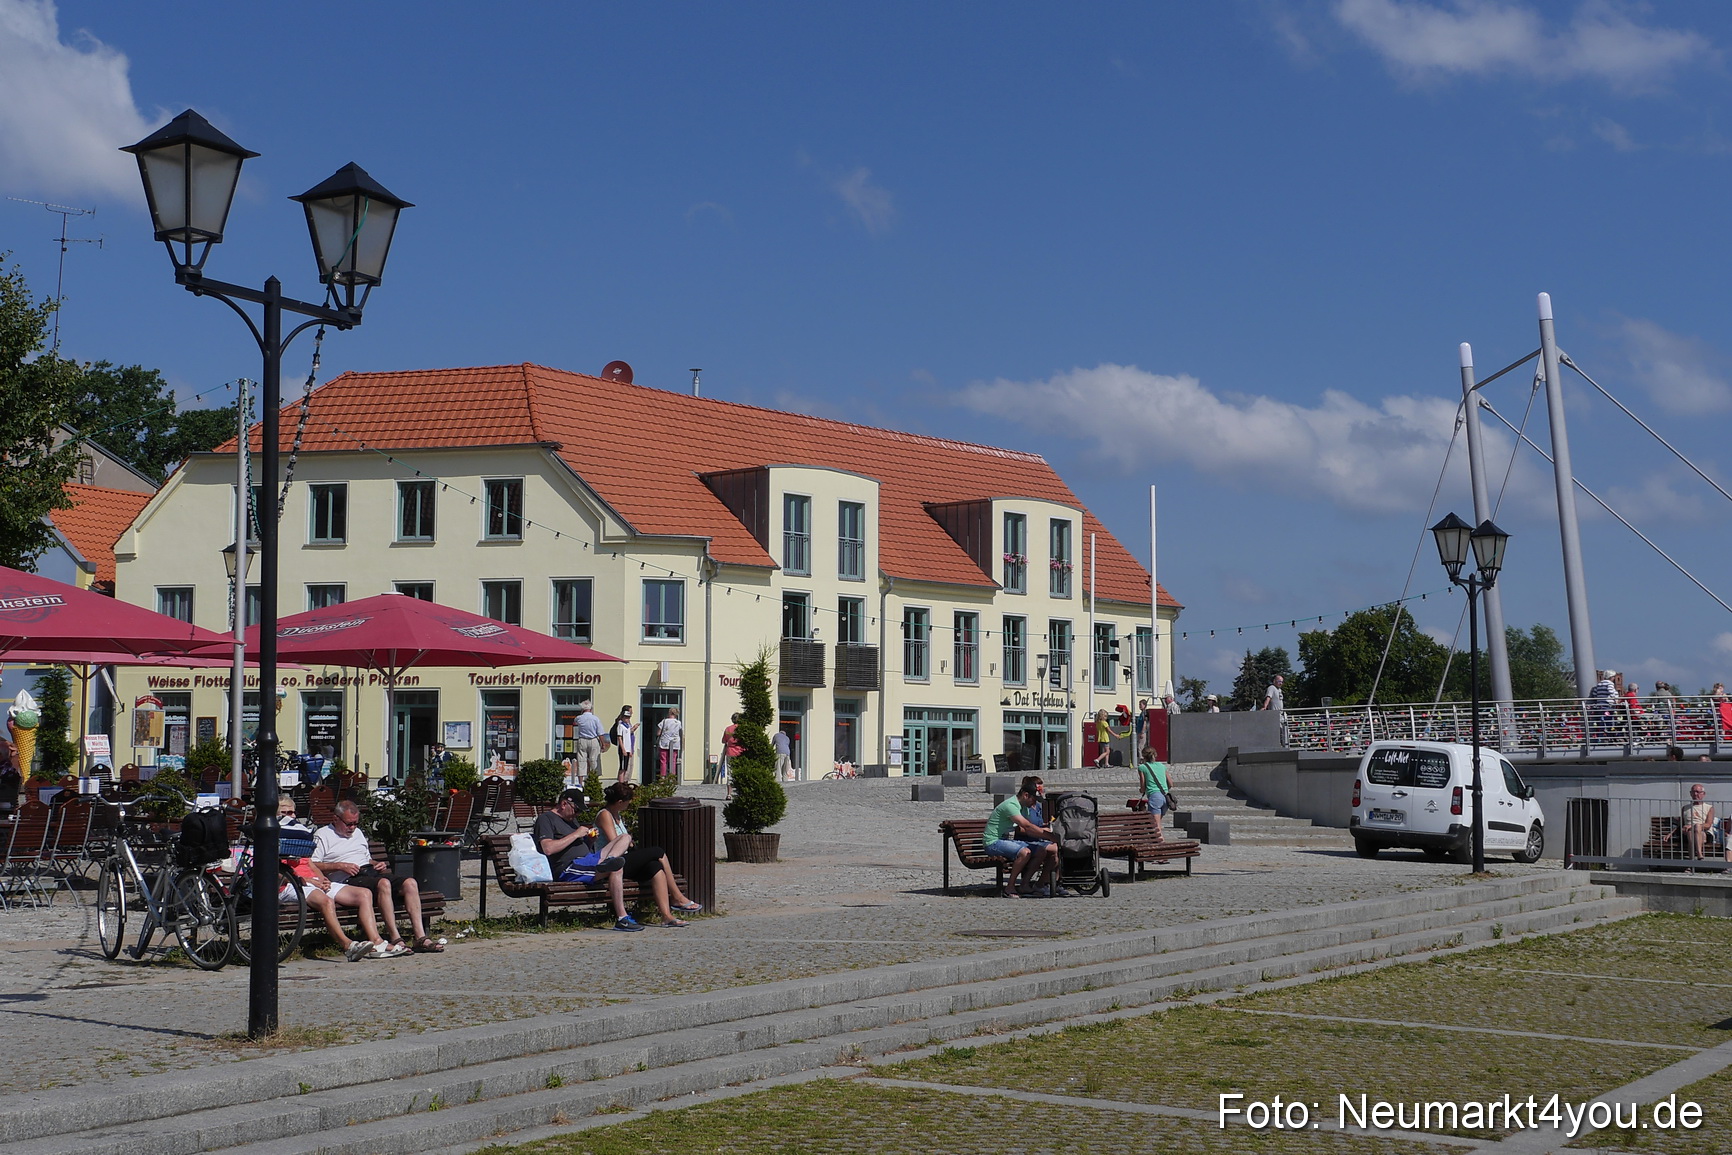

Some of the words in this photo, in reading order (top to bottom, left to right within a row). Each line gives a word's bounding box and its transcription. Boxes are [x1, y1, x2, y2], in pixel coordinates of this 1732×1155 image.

[147, 675, 190, 688] Weisse
[194, 675, 230, 688] Flotte
[305, 674, 364, 687] Reederei
[468, 672, 601, 685] Tourist-Information
[1014, 691, 1029, 706] Dat
